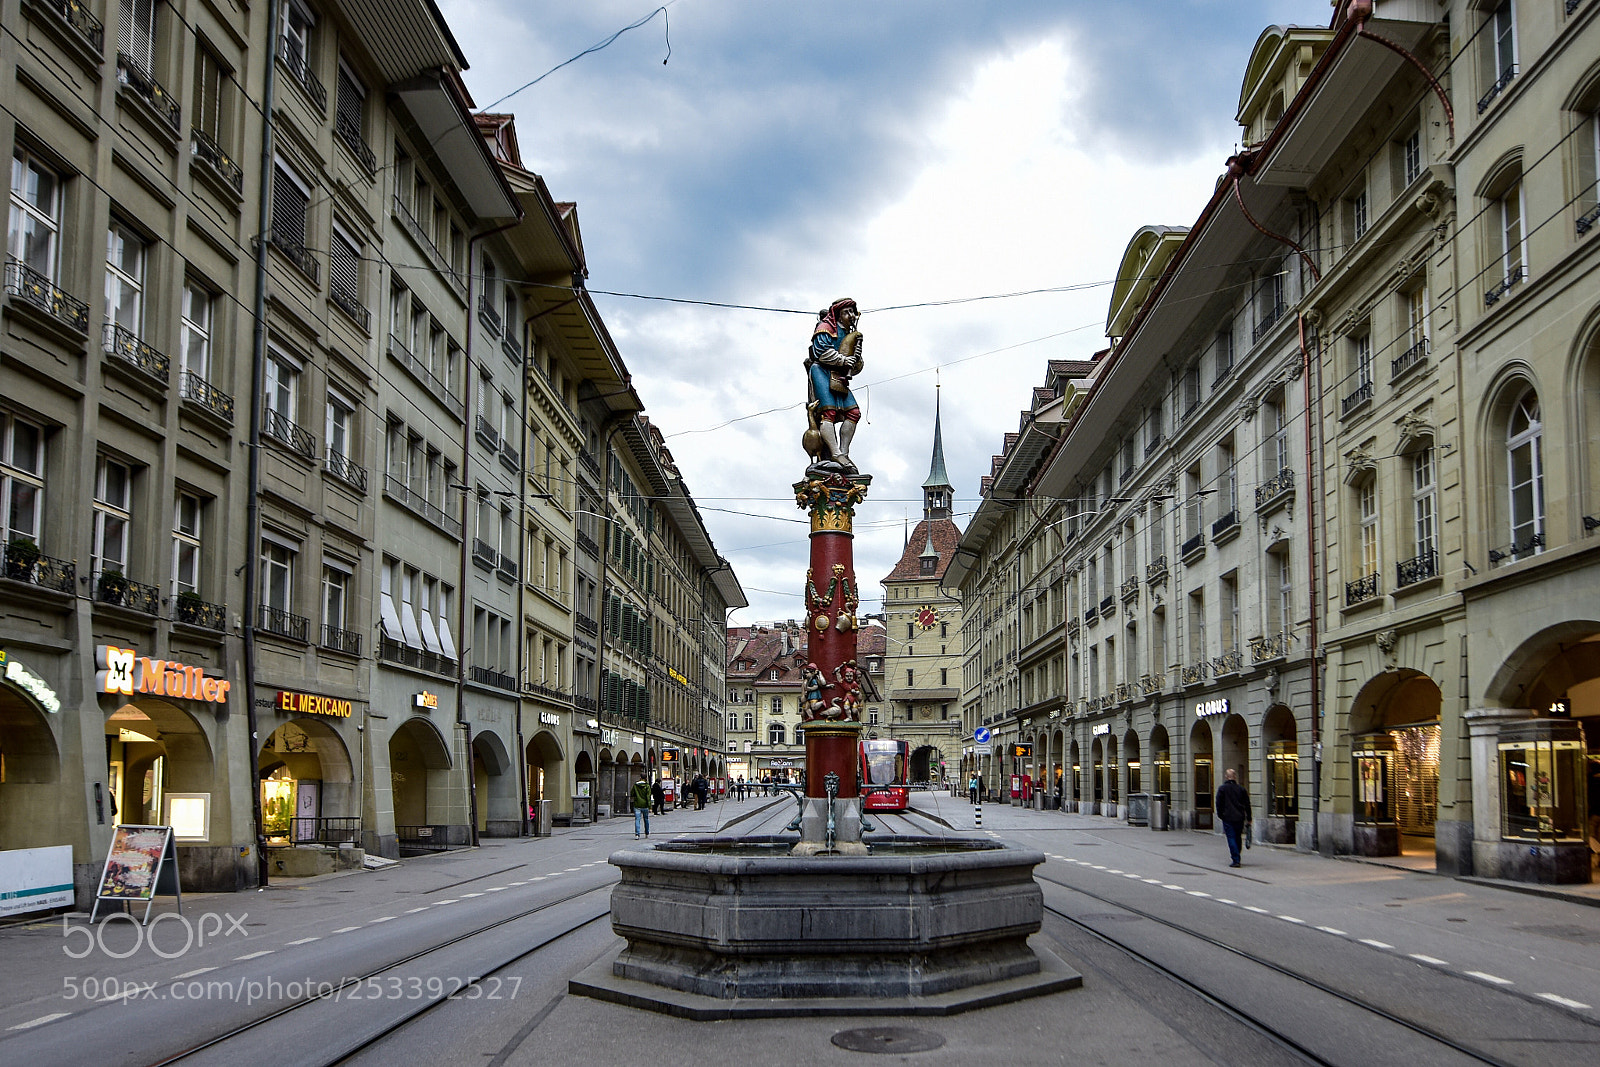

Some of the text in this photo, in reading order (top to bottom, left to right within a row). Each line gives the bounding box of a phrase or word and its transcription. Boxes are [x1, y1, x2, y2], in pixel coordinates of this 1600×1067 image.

[139, 656, 231, 704] Müller
[282, 691, 352, 718] EL MEXICANO
[1195, 698, 1229, 717] GLOBUS
